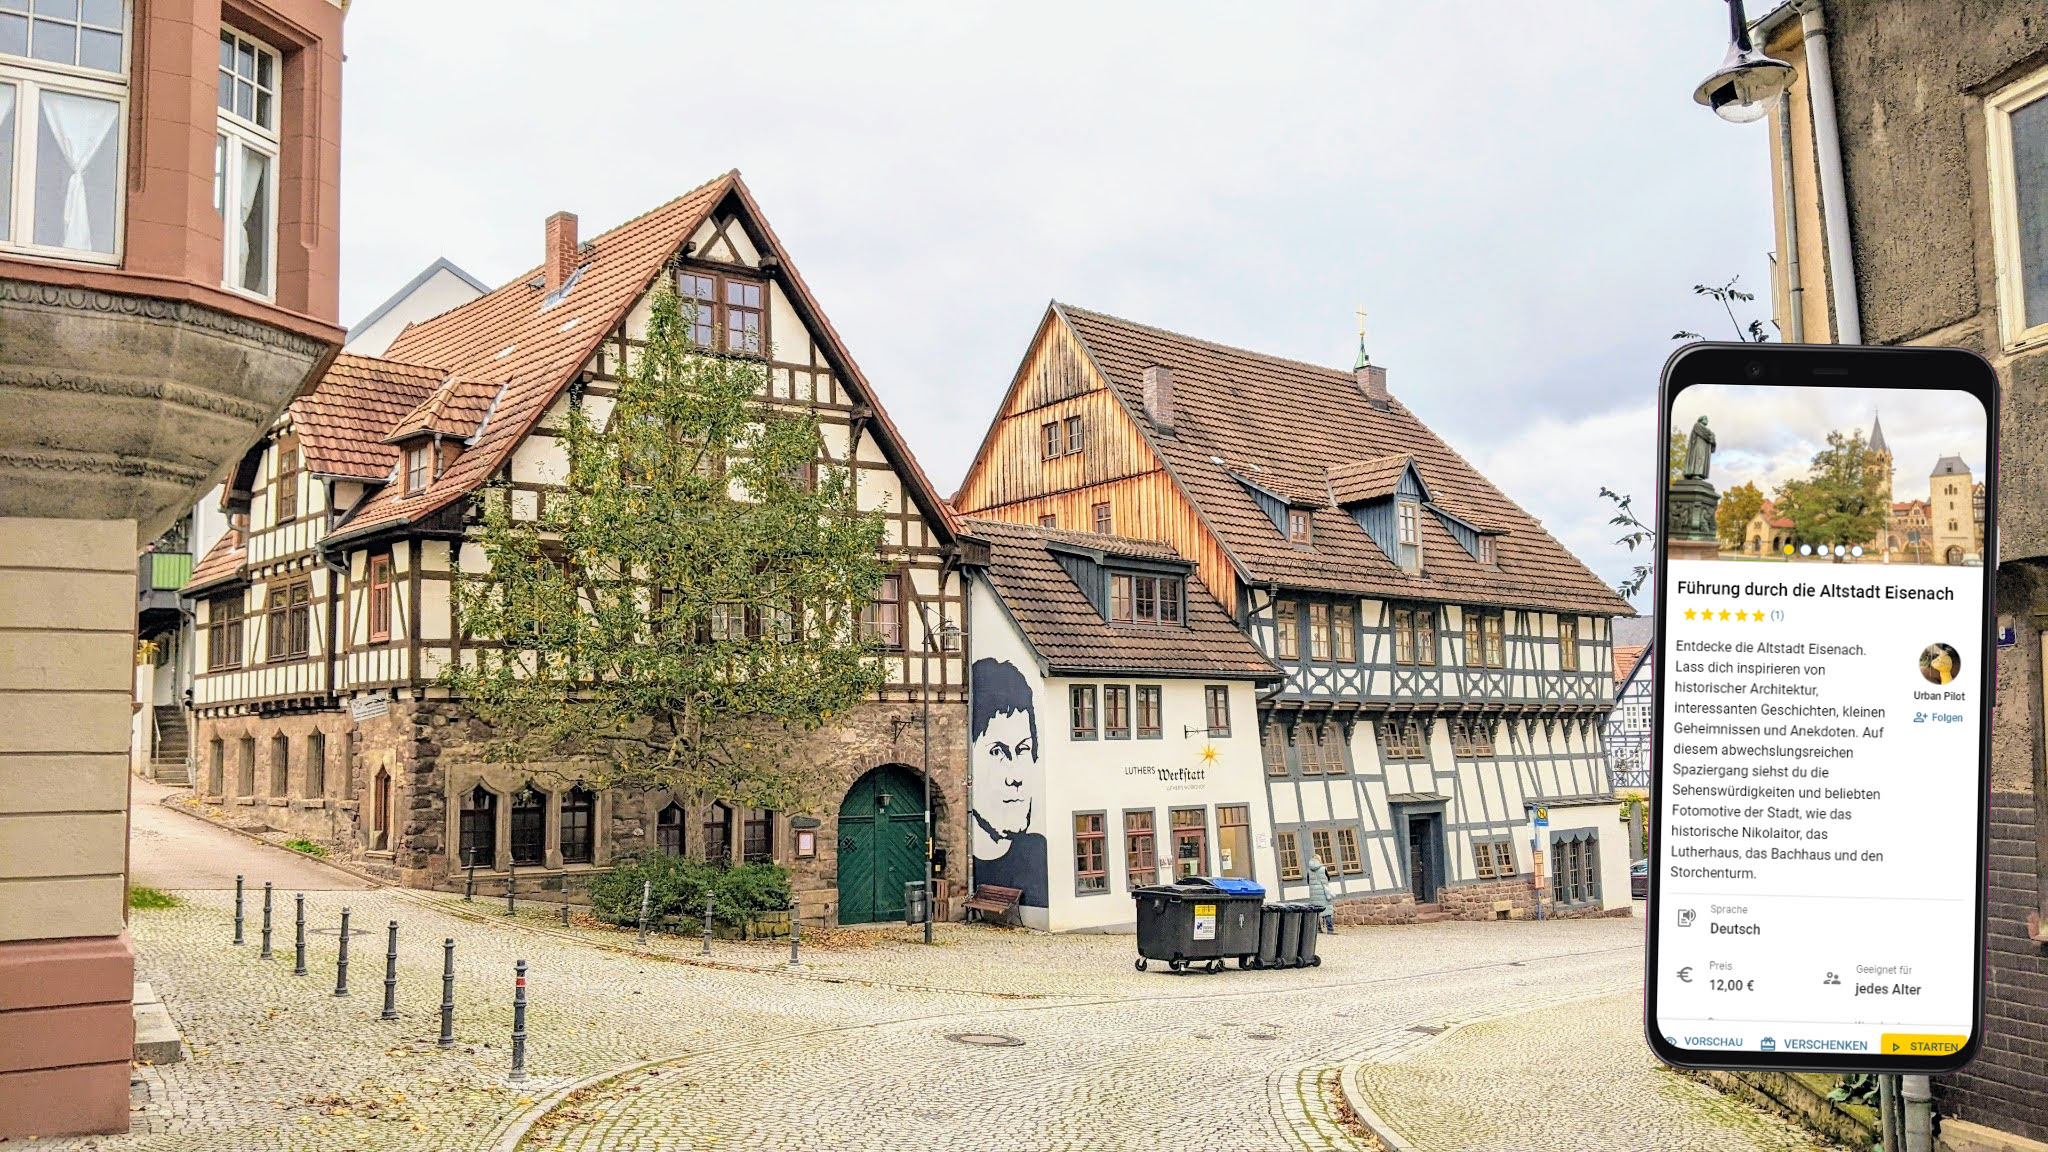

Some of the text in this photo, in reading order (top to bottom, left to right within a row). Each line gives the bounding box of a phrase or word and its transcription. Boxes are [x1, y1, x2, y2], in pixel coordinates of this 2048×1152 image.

[1678, 581, 1953, 600] Führung durch die Altstadt Eisenach
[1771, 609, 1785, 622] (1)
[1676, 640, 1866, 655] Entdecke die Altstadt Eisenach.
[1676, 661, 1825, 676] Lass dich inspirieren von
[1675, 681, 1818, 696] historischer Architektur,
[1914, 690, 1965, 700] Urban Pilot
[1675, 702, 1885, 717] interessanten Geschichten, kleinen
[1931, 712, 1963, 723] Folgen
[1674, 722, 1884, 738] Geheimnissen und Anekdoten. Auf
[1674, 743, 1853, 759] diesem abwechslungsreichen
[1125, 766, 1156, 775] LUTHERS
[1673, 763, 1829, 778] Spaziergang siehst du die
[1673, 784, 1880, 799] Sehenswürdigkeiten und beliebten
[1673, 804, 1851, 820] Fotomotive der Stadt, wie das
[1672, 825, 1827, 840] historische Nikolaitor, das
[1672, 846, 1883, 861] Lutherhaus, das Bachhaus und den
[1671, 866, 1756, 878] Storchenturm.
[1710, 904, 1748, 916] Sprache
[1711, 923, 1760, 934] Deutsch
[1710, 961, 1731, 970] Preis
[1856, 963, 1912, 976] Geeignet für
[1710, 979, 1754, 992] 12,00 €
[1855, 983, 1921, 996] jedes Alter
[1684, 1036, 1743, 1048] VORSCHAU
[1784, 1038, 1868, 1051] VERSCHENKEN
[1910, 1041, 1958, 1052] STARTEN
